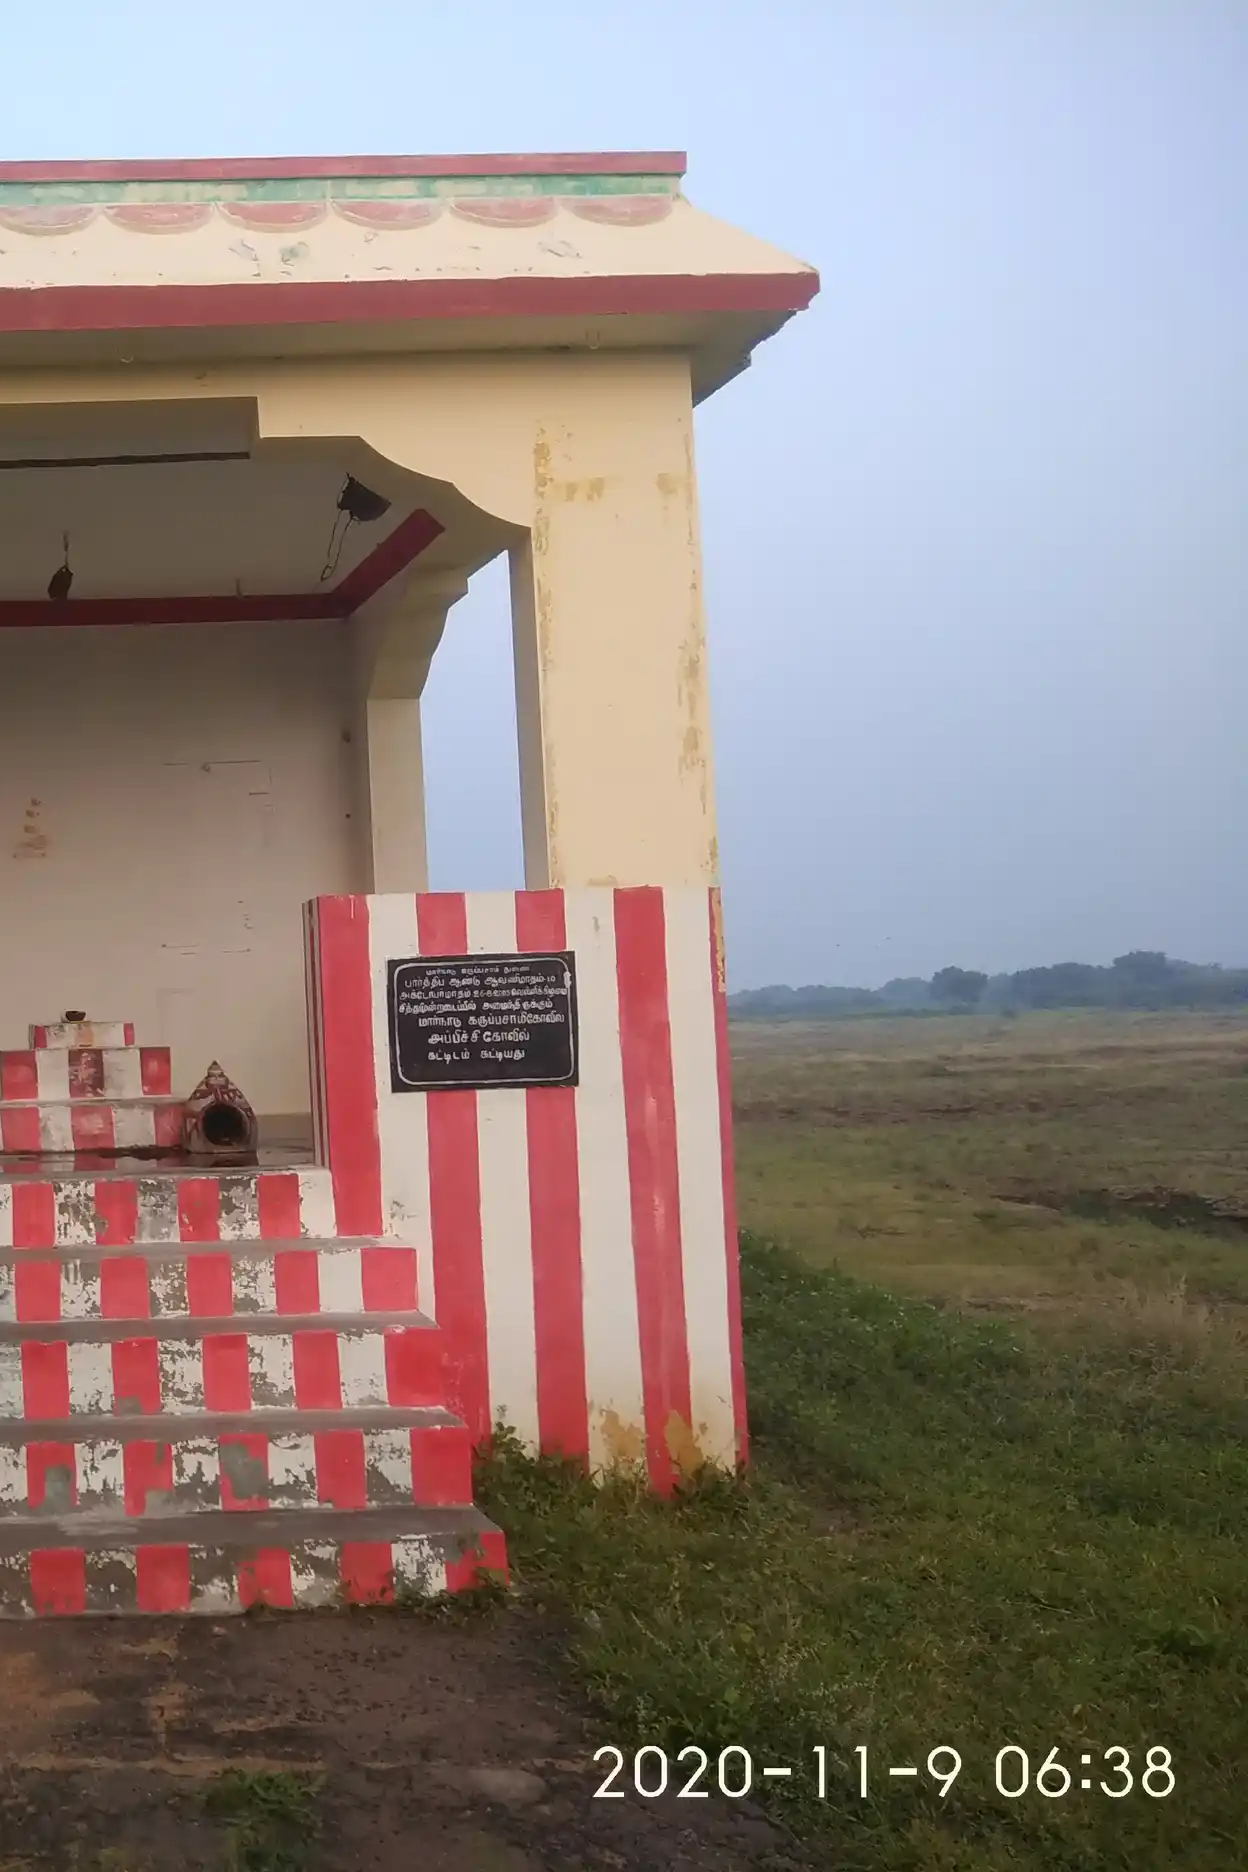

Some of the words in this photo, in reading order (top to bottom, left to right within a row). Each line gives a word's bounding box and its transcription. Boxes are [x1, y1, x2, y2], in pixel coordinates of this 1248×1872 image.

[483, 1028, 530, 1042] கோவில்
[428, 1048, 470, 1064] கட்டிடம்
[480, 1048, 525, 1061] கட்டியது
